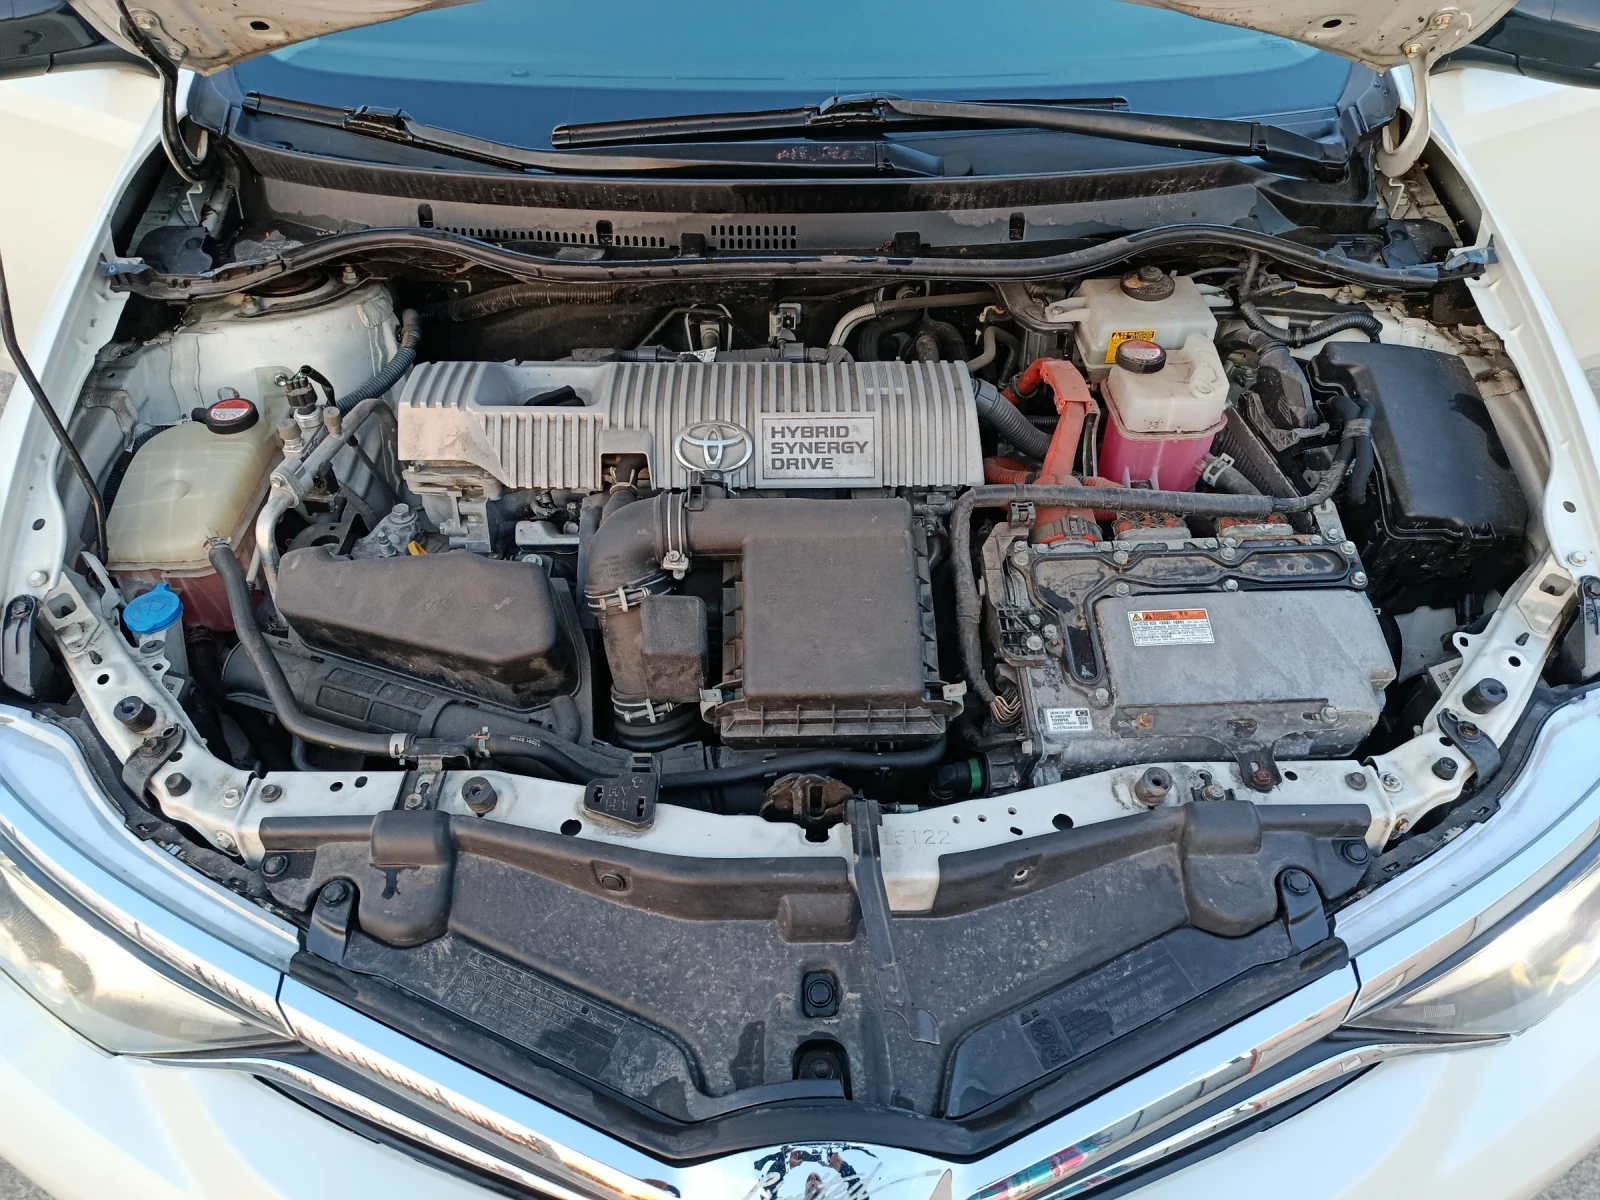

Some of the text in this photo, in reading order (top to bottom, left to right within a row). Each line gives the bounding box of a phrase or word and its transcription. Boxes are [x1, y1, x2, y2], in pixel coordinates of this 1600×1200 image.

[771, 425, 850, 439] HYBRID
[771, 441, 869, 455] SYNERGY
[771, 457, 834, 470] DRIVE
